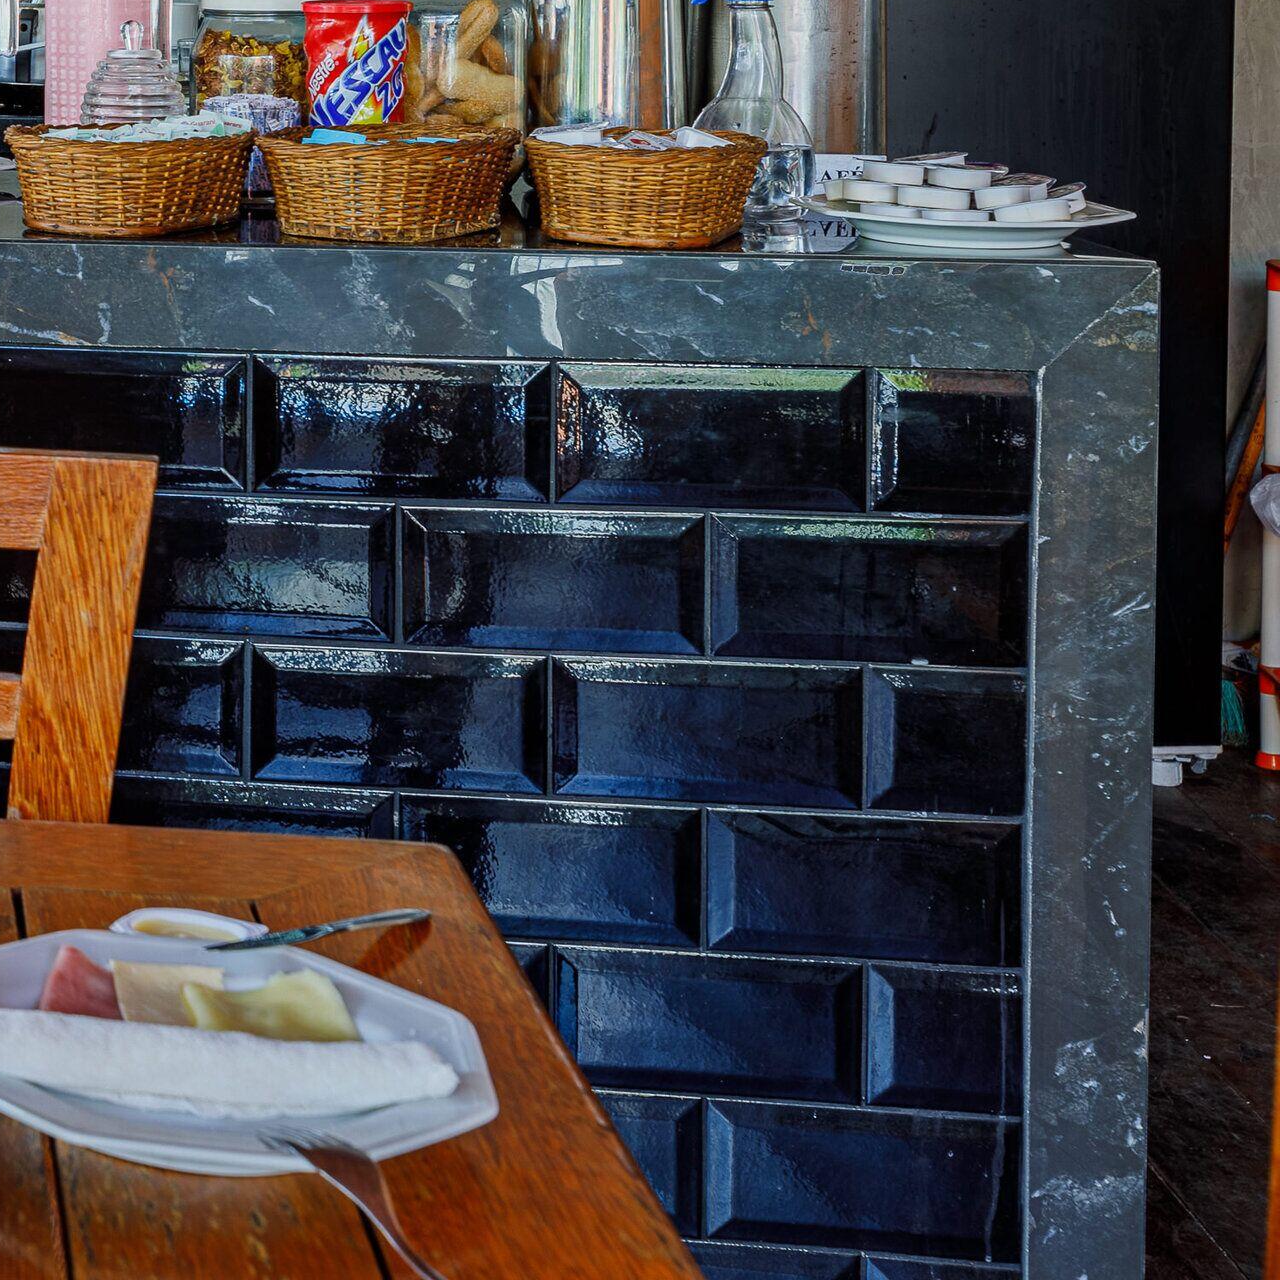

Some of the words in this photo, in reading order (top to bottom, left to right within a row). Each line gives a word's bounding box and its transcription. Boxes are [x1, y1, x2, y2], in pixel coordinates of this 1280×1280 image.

[308, 52, 336, 101] Nestlé
[309, 17, 408, 126] NESCAU
[815, 166, 864, 184] AFÉ
